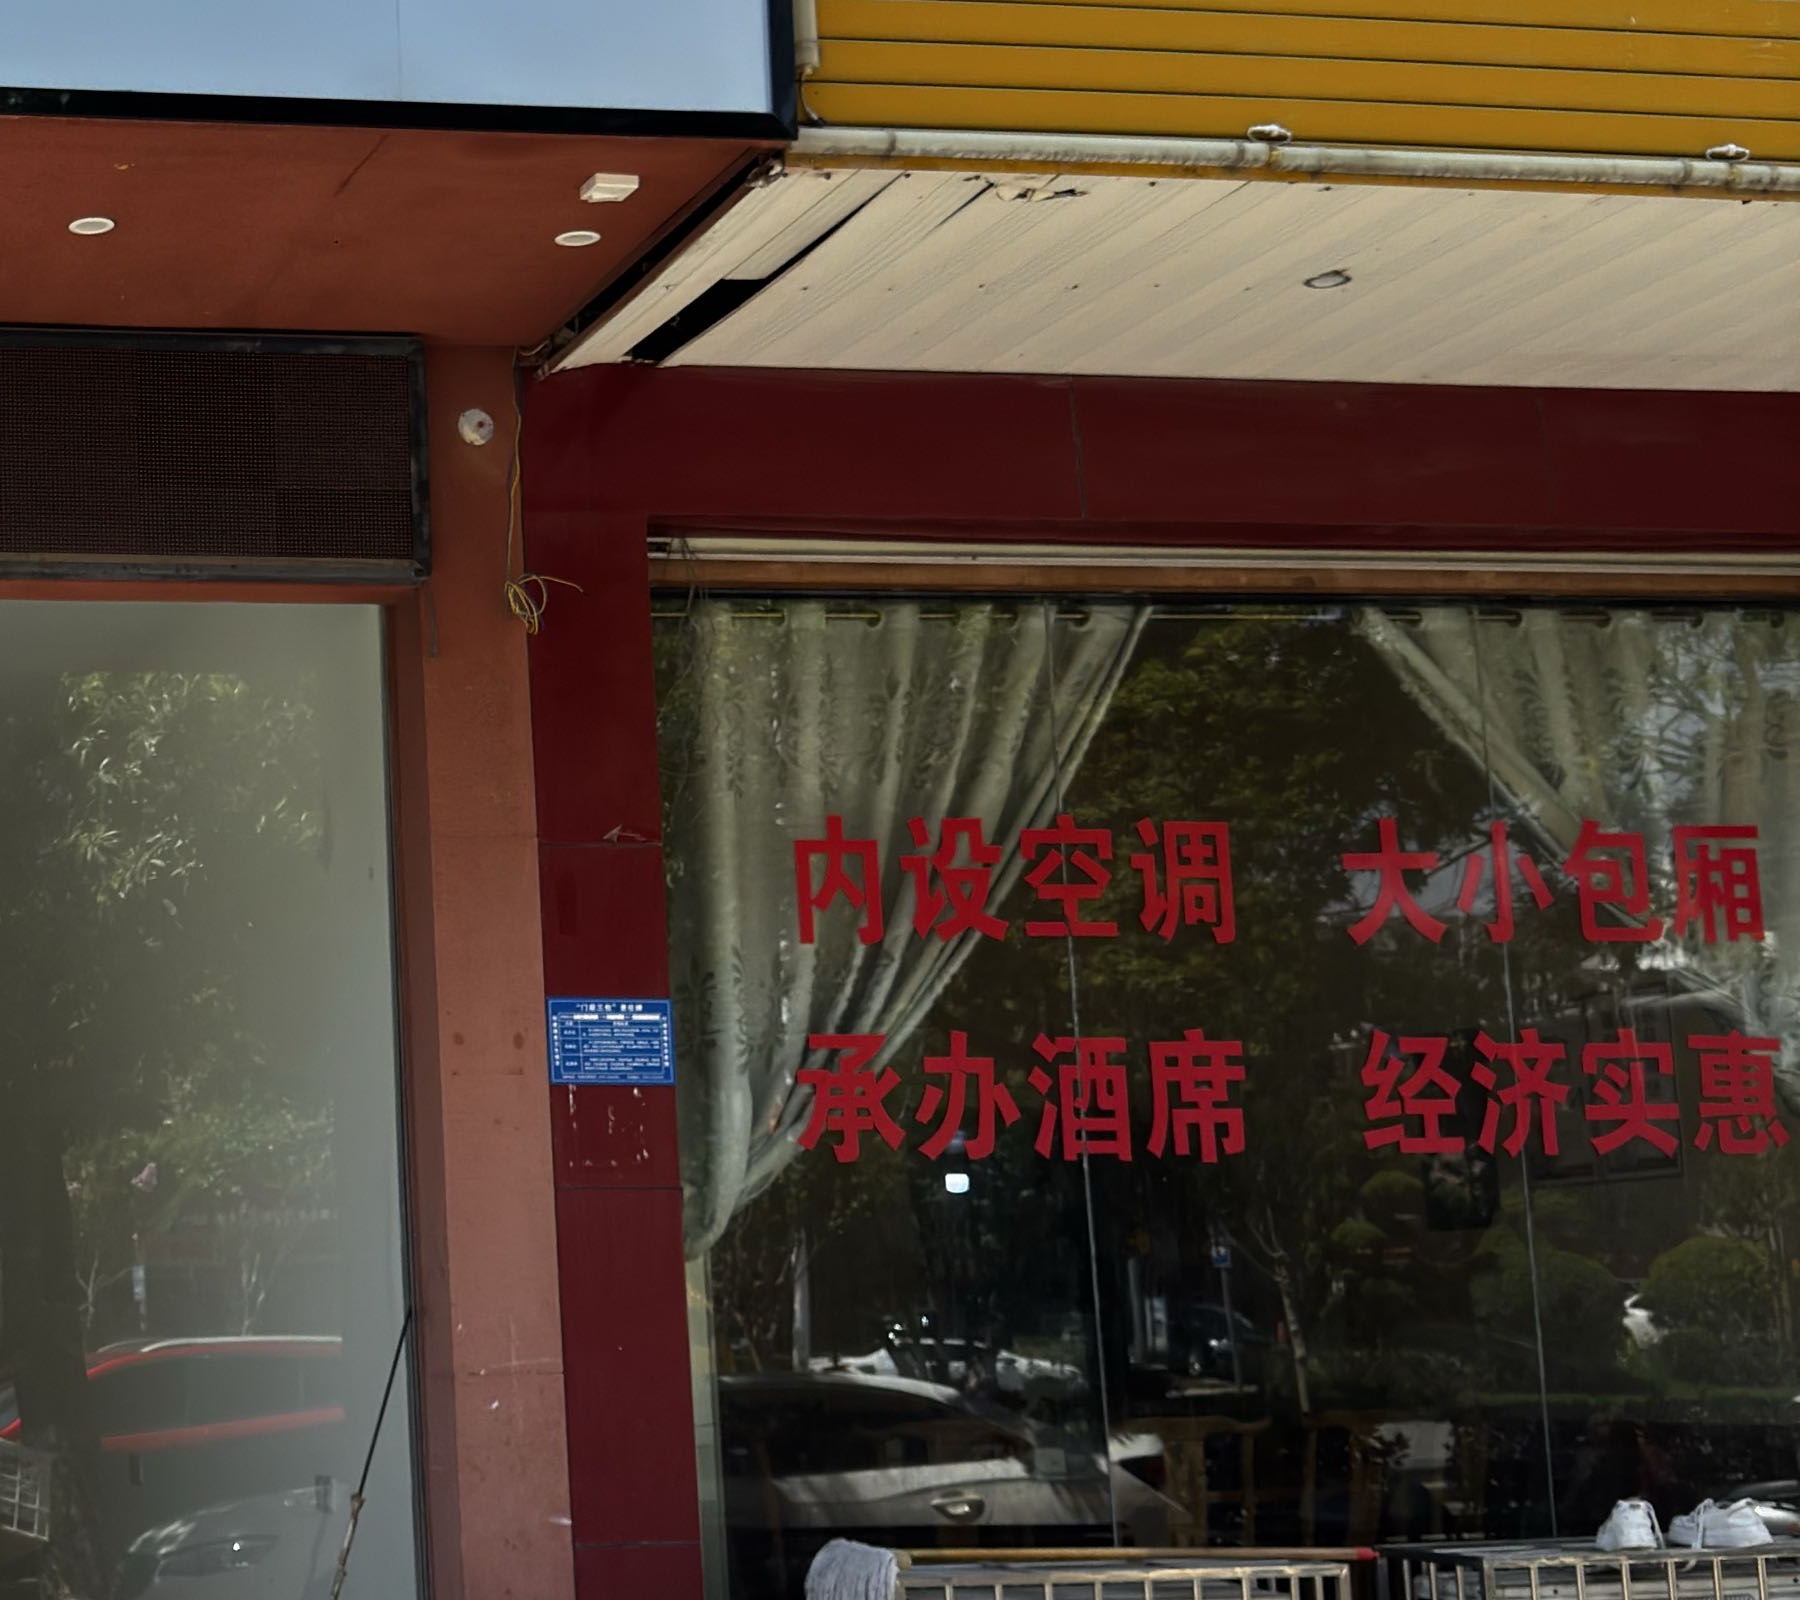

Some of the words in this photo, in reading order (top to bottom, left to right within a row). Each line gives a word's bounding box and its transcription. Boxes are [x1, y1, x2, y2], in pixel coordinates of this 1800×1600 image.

[794, 813, 1239, 947] 内设空调
[1341, 818, 1767, 947] 大小包厢
[796, 1027, 1247, 1164] 承办酒席
[1361, 1027, 1792, 1162] 经济实惠
